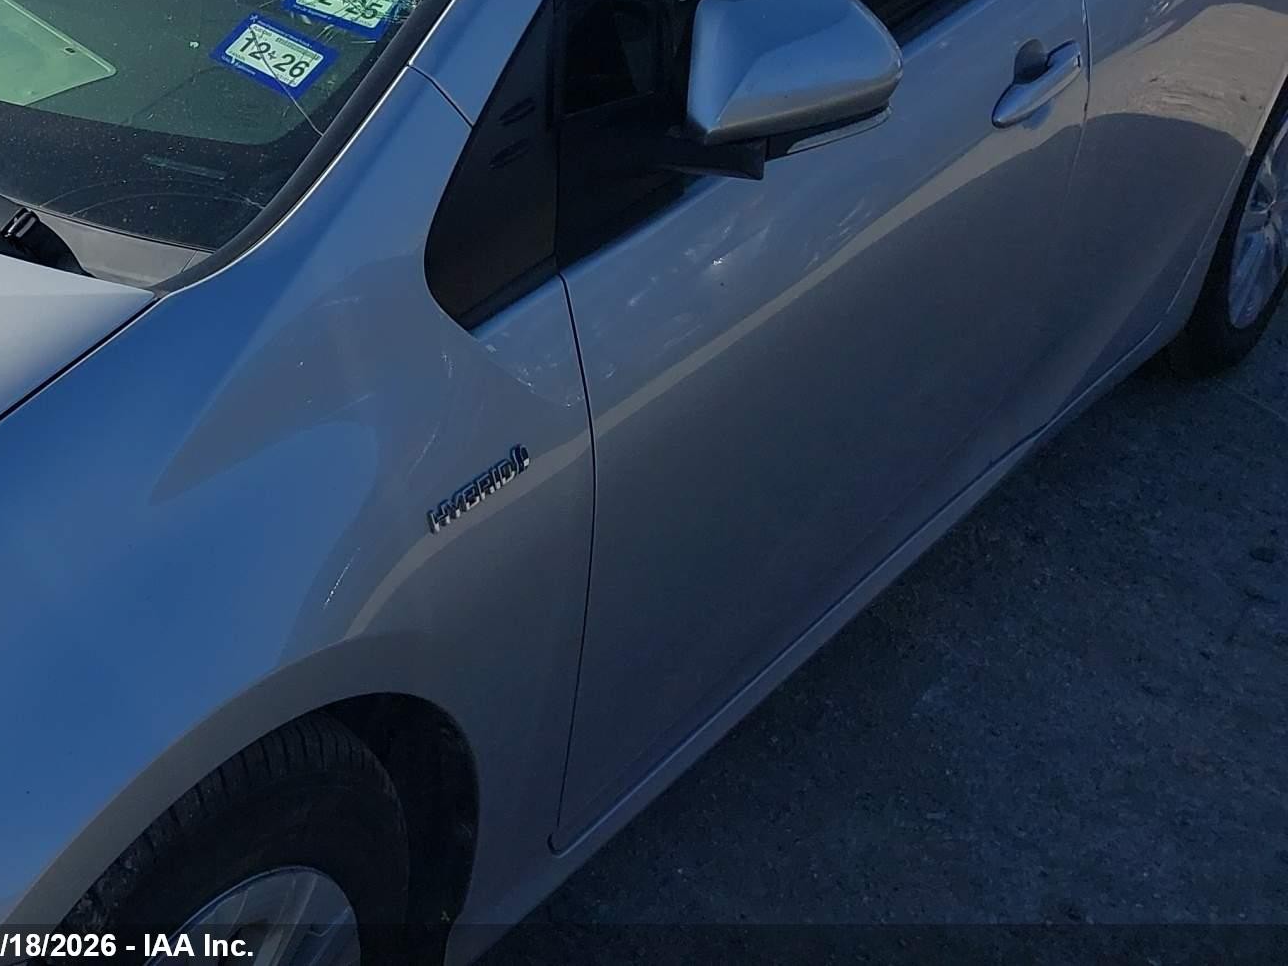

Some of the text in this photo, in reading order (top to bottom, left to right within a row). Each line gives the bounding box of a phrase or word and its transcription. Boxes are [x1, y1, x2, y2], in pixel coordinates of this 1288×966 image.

[239, 34, 271, 61] 12
[273, 53, 310, 78] 26
[427, 459, 516, 533] HYBRID
